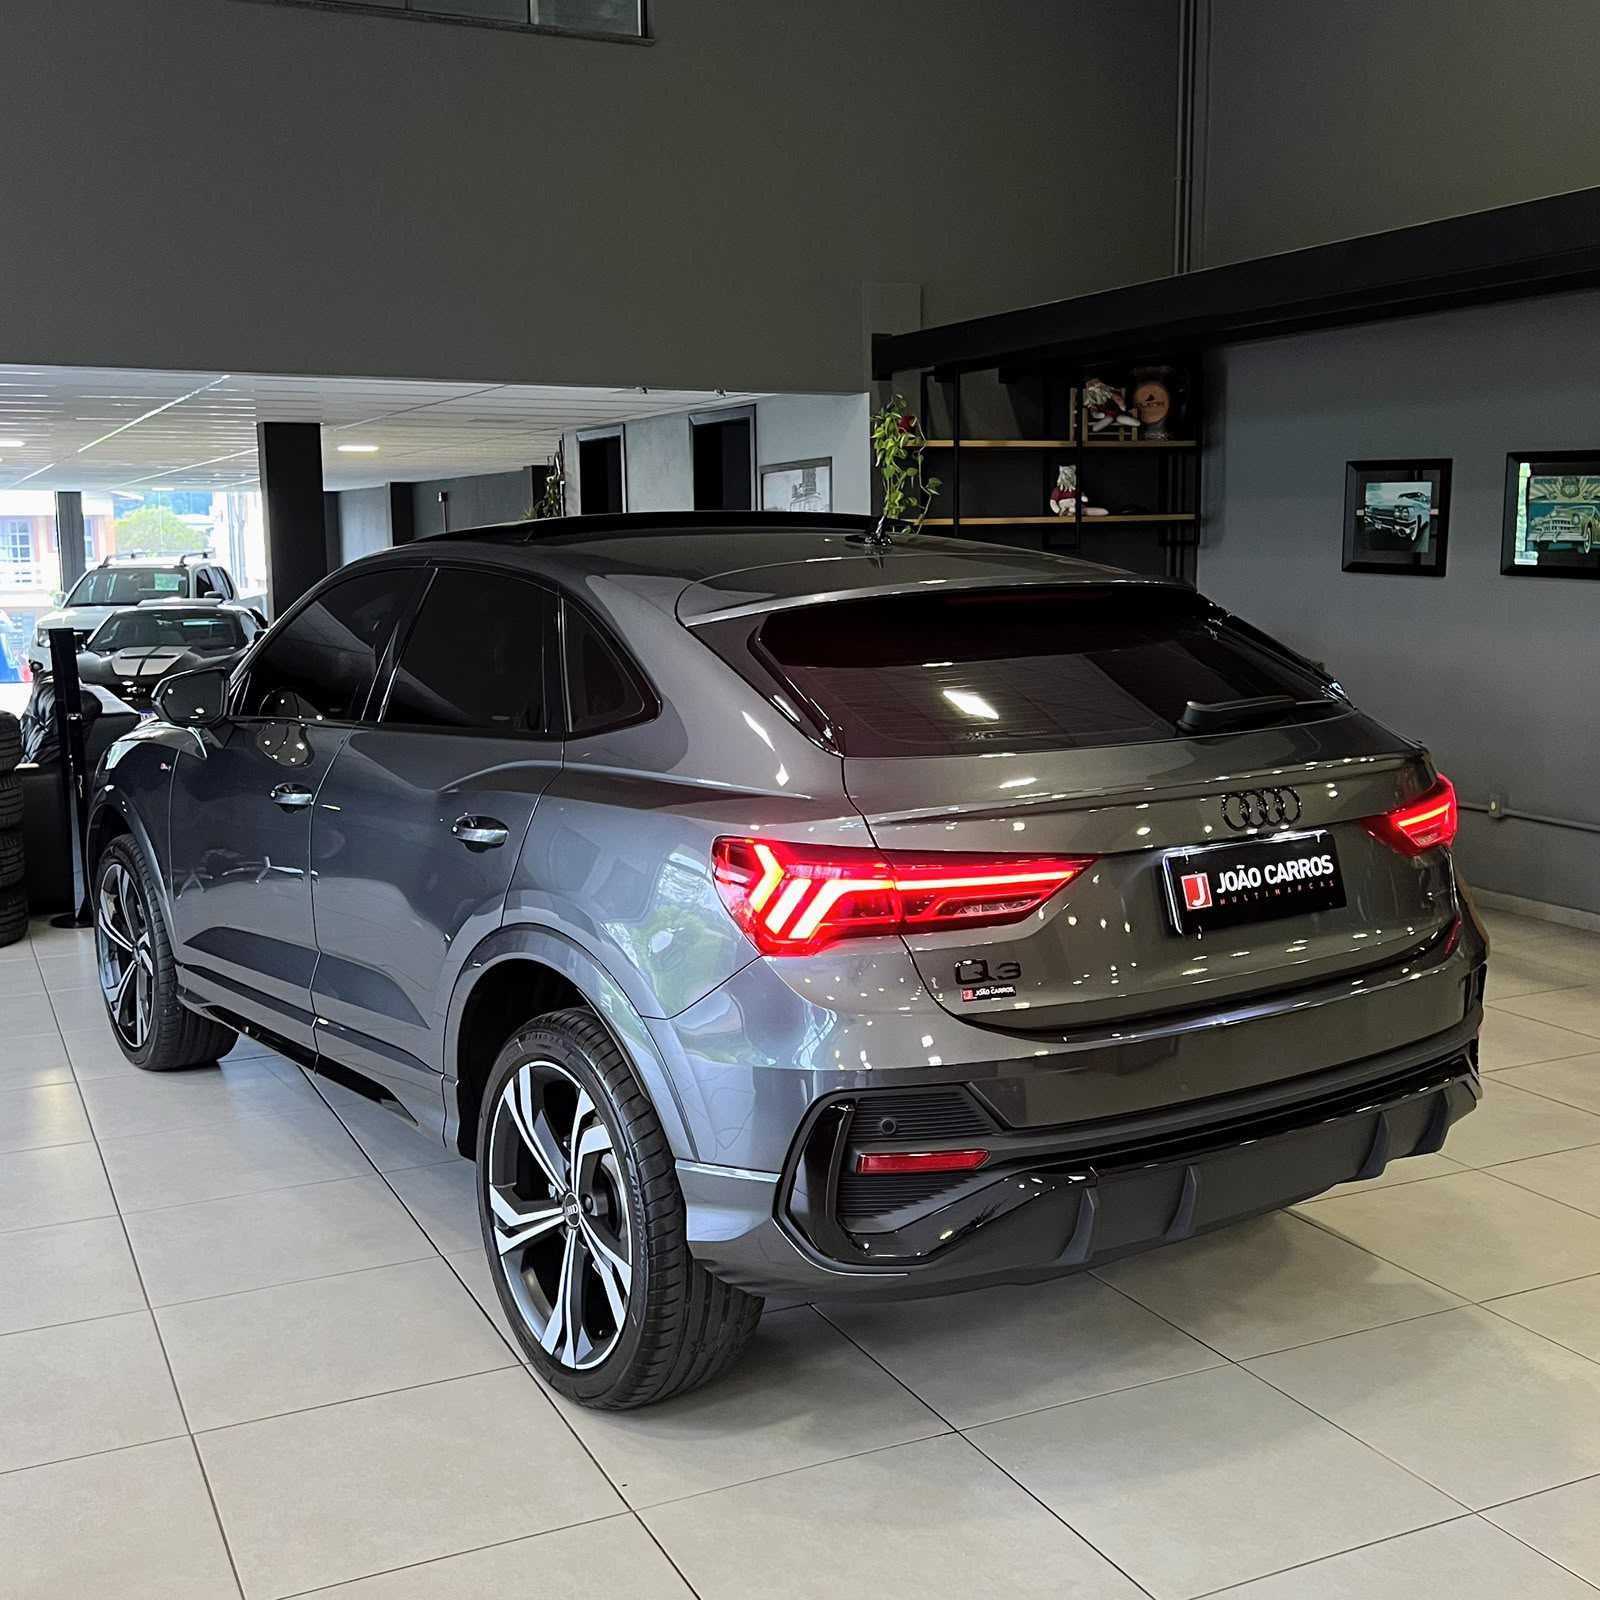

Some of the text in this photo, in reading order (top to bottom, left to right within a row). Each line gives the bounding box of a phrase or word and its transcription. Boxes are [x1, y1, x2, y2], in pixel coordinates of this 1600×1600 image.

[1216, 854, 1335, 894] JOÃO CARROS
[1219, 880, 1335, 906] MULTIMARCAS
[954, 959, 1022, 985] Q3
